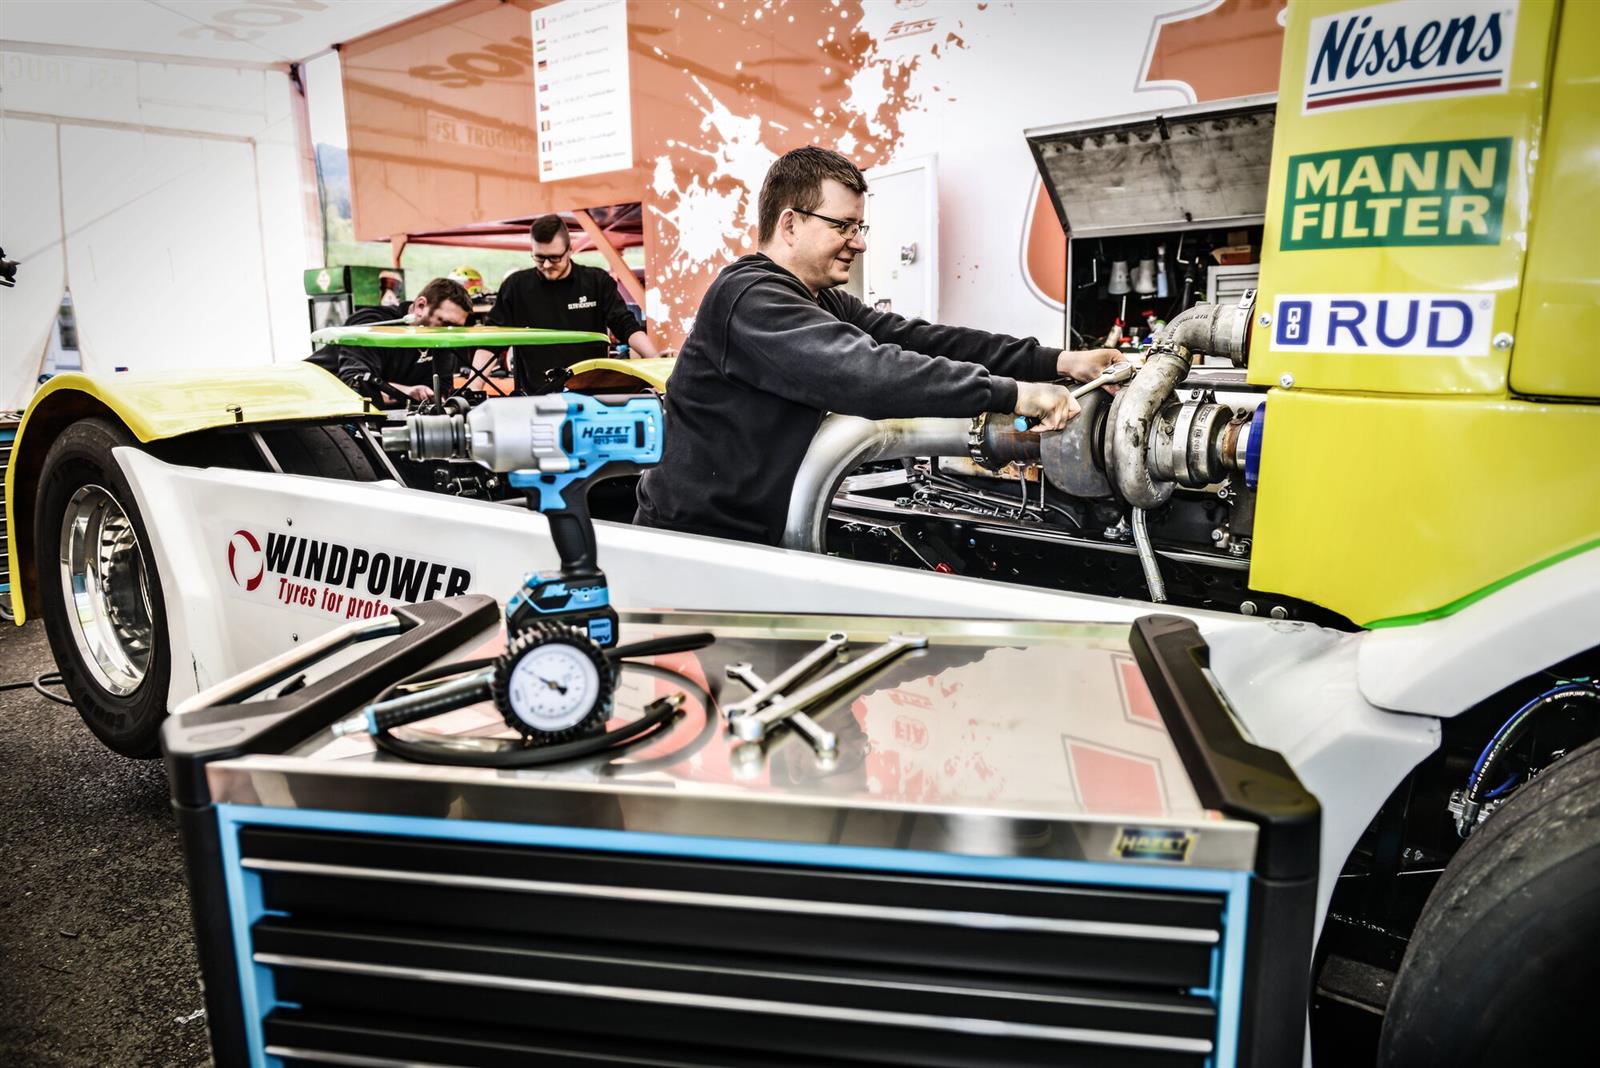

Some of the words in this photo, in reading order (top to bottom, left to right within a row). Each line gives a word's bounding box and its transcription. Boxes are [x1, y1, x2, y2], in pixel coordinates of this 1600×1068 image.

[1310, 11, 1503, 86] Nissens
[1295, 147, 1498, 199] MANN
[1290, 195, 1491, 241] FILTER
[1326, 299, 1474, 348] RUD
[582, 426, 632, 439] HAZET
[265, 532, 472, 604] WINDPOWER
[278, 577, 317, 608] Tyres
[321, 587, 344, 613] for
[346, 596, 389, 619] profe
